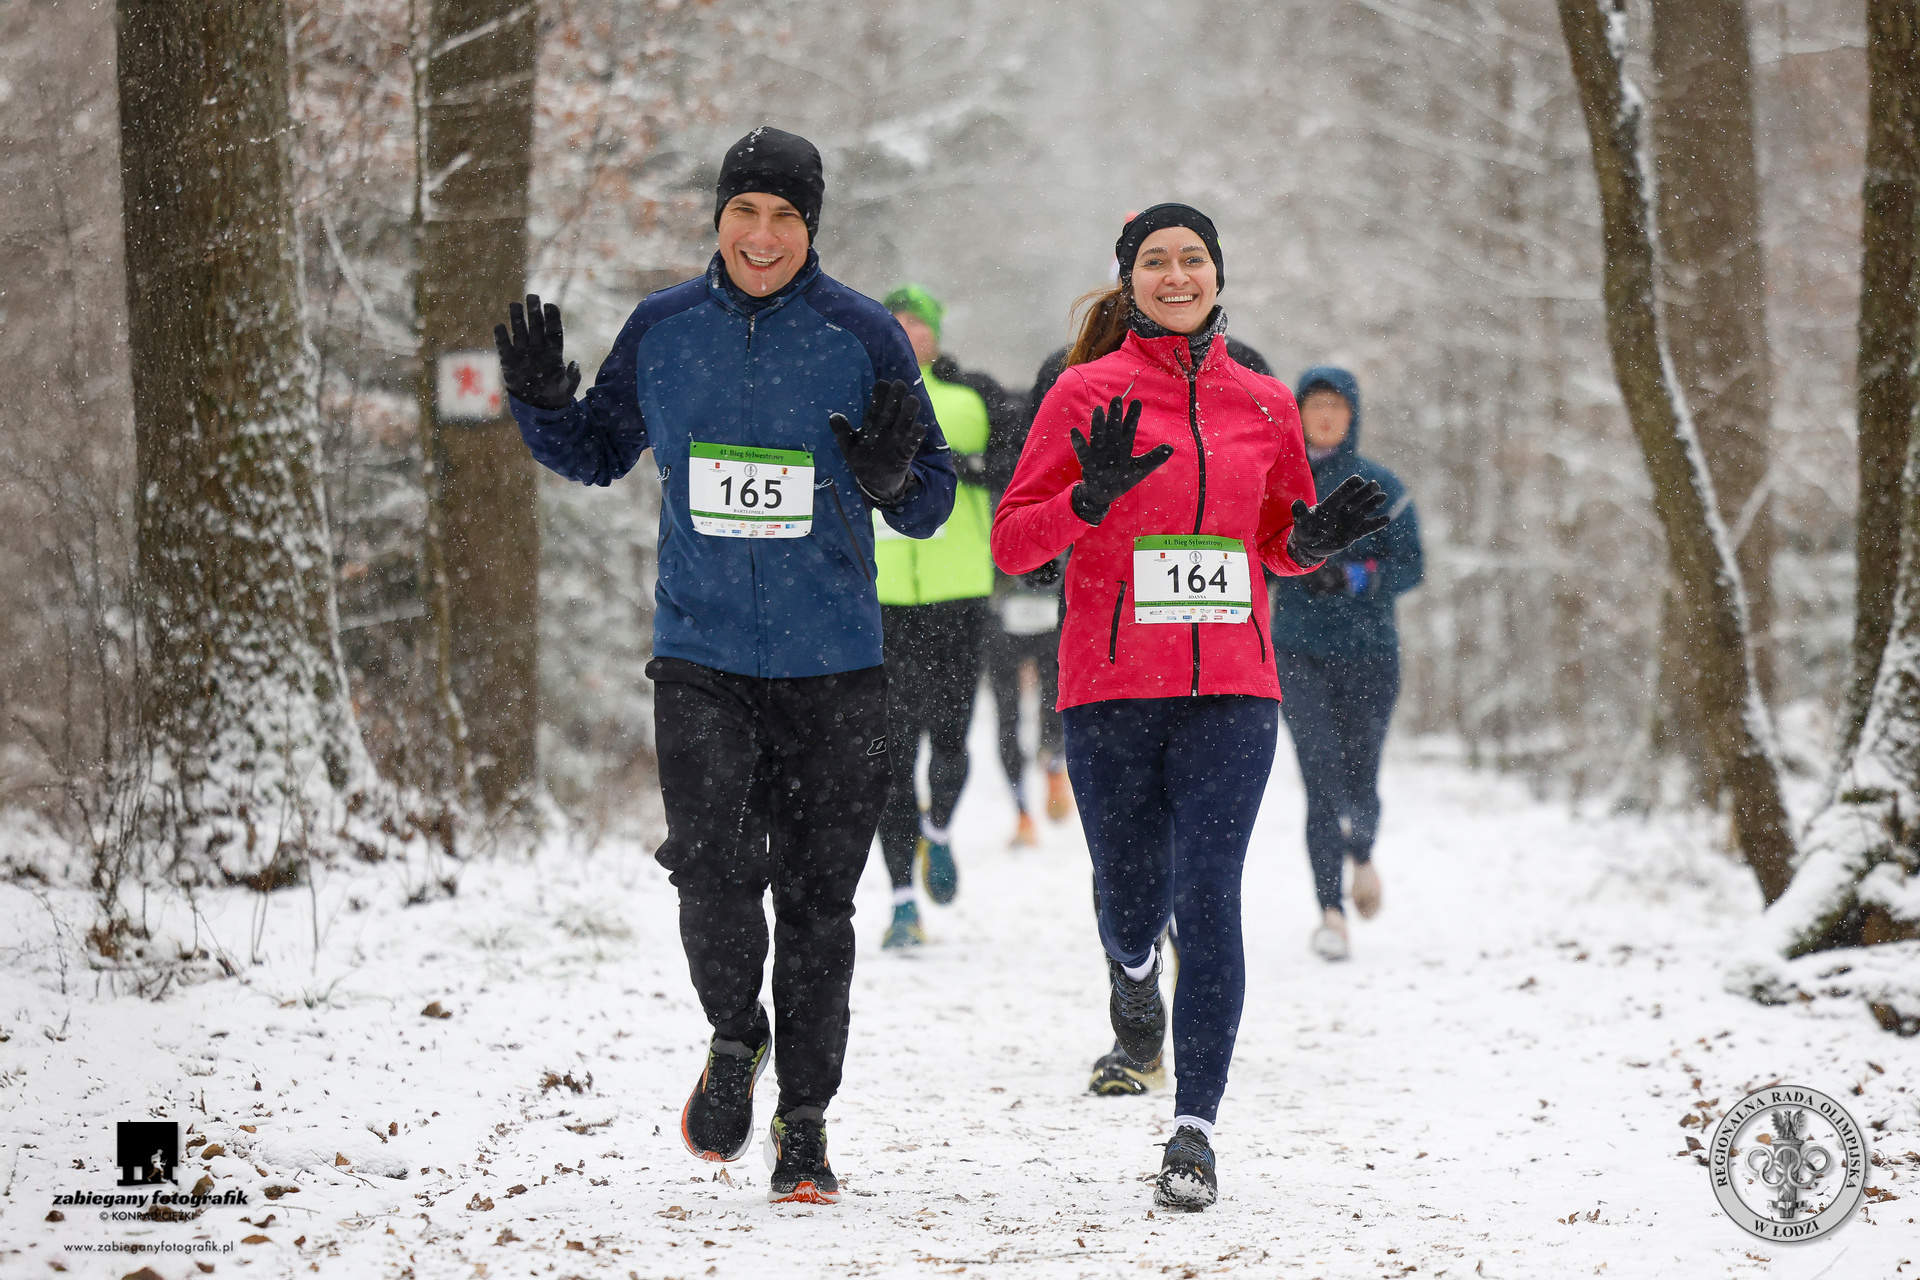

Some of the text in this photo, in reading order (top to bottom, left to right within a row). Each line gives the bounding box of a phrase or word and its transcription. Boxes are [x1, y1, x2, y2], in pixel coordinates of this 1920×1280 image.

[720, 476, 782, 509] 165
[1174, 539, 1188, 547] Bieg
[1167, 564, 1228, 594] 164
